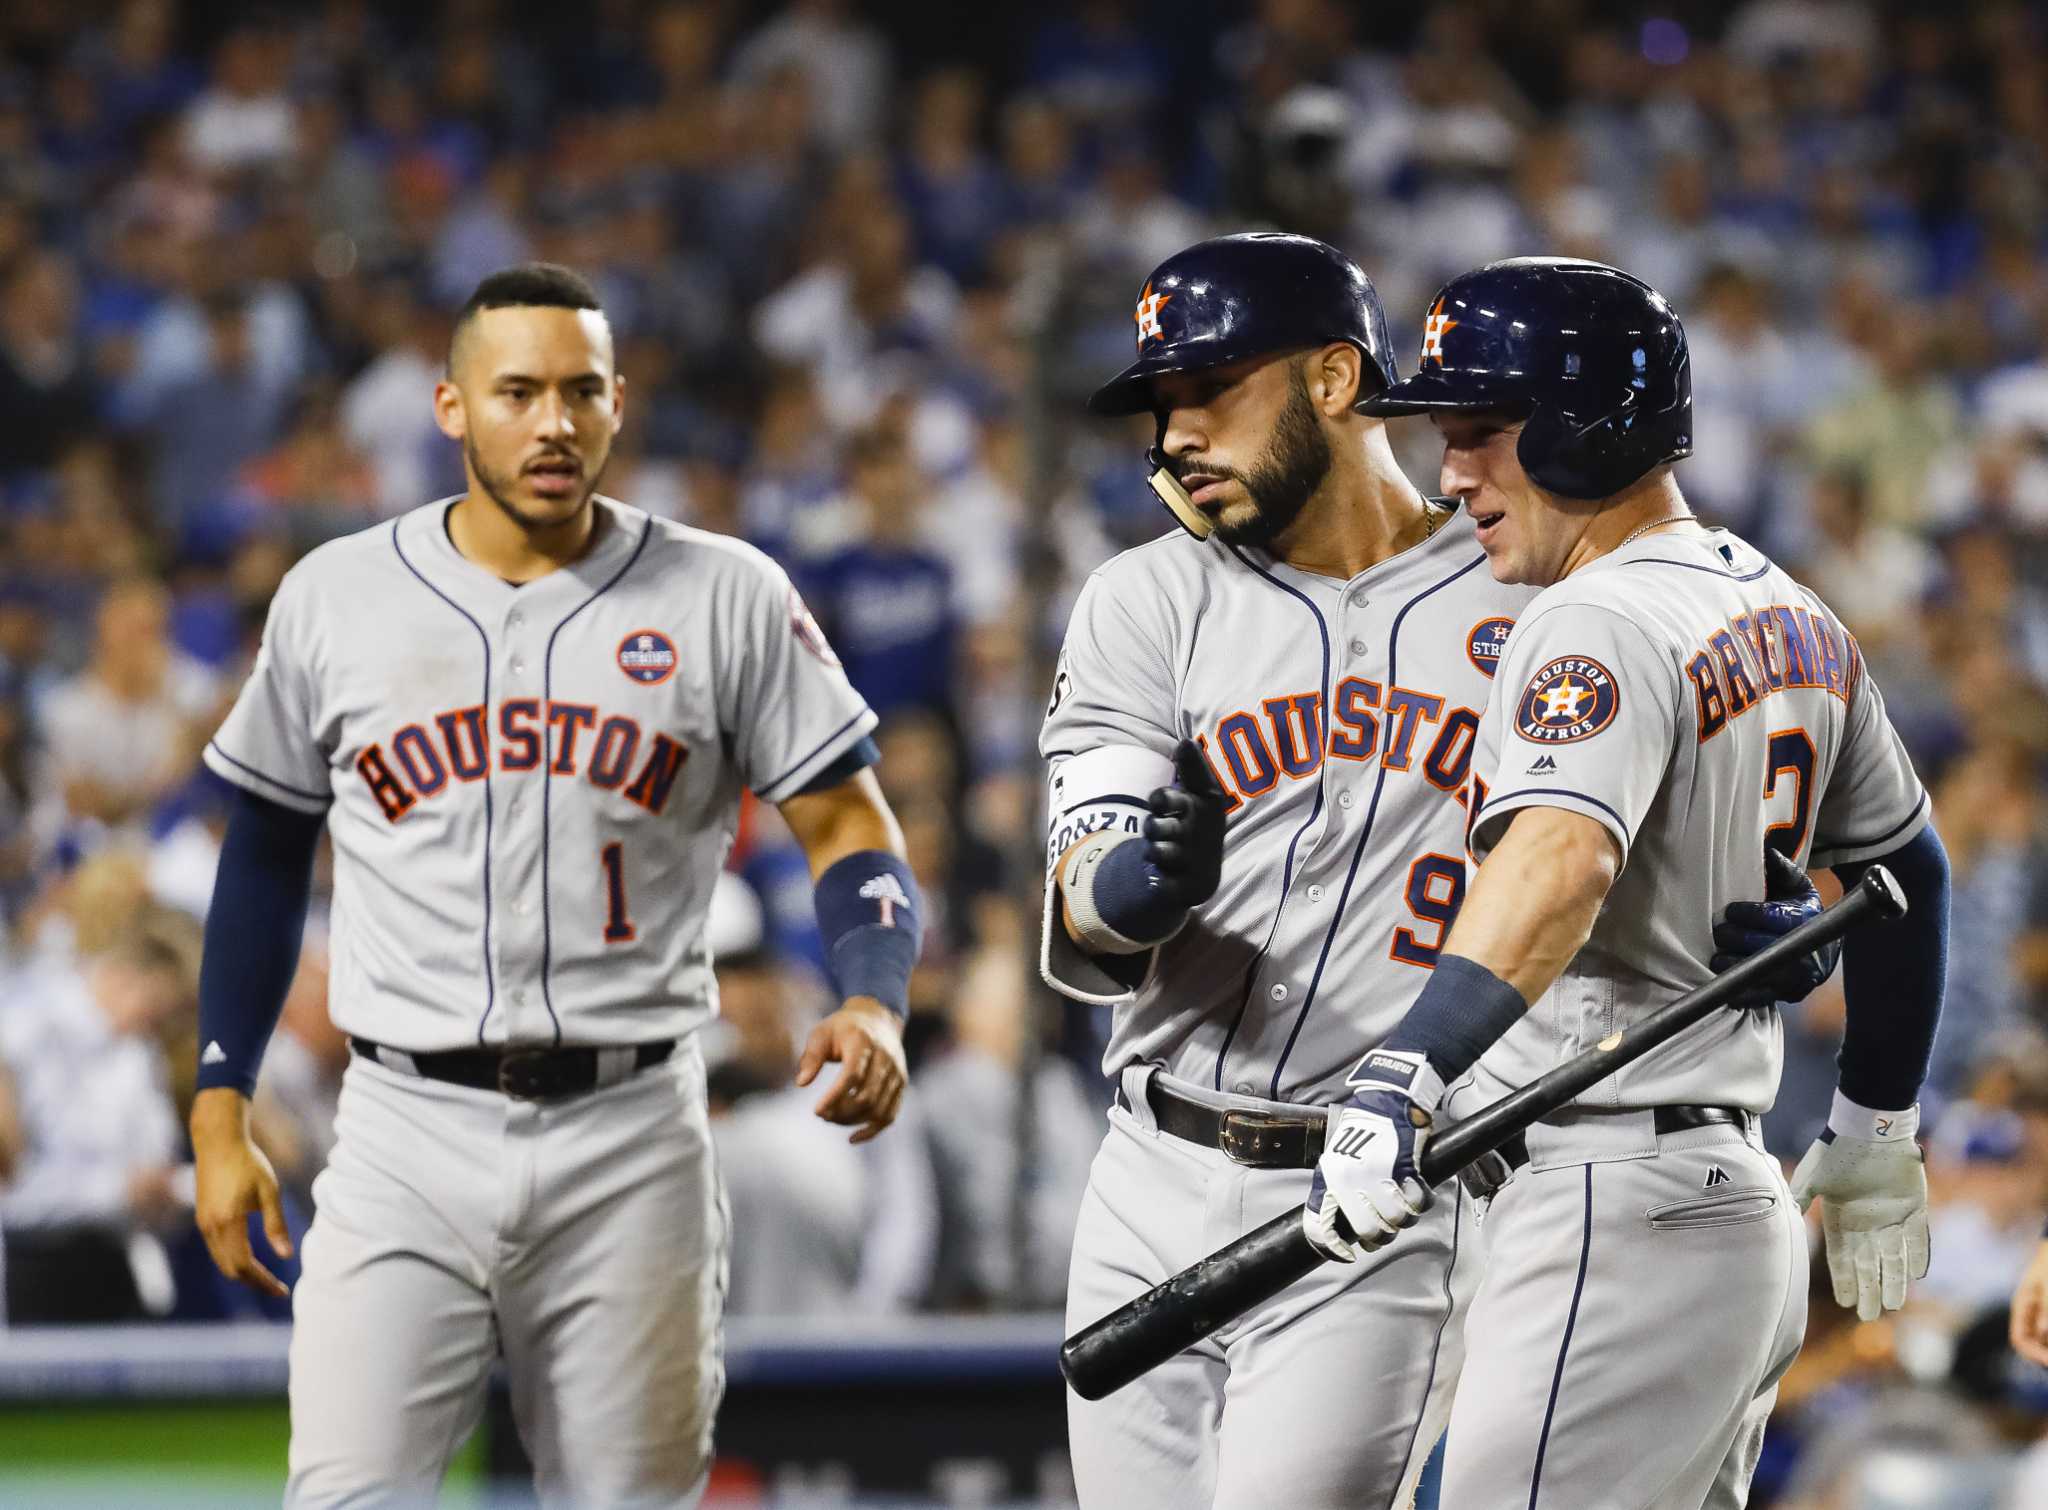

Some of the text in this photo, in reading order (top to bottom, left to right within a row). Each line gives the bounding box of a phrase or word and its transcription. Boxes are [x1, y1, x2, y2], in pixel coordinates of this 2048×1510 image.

[1137, 292, 1163, 343] H
[1421, 314, 1449, 356] H
[1472, 641, 1506, 656] STR
[1531, 660, 1609, 691] HOUSTON
[1542, 686, 1584, 716] H
[1523, 719, 1595, 740] ASTROS
[356, 699, 690, 822] HOUSTON
[602, 842, 636, 944] 1
[1390, 852, 1466, 970] 9
